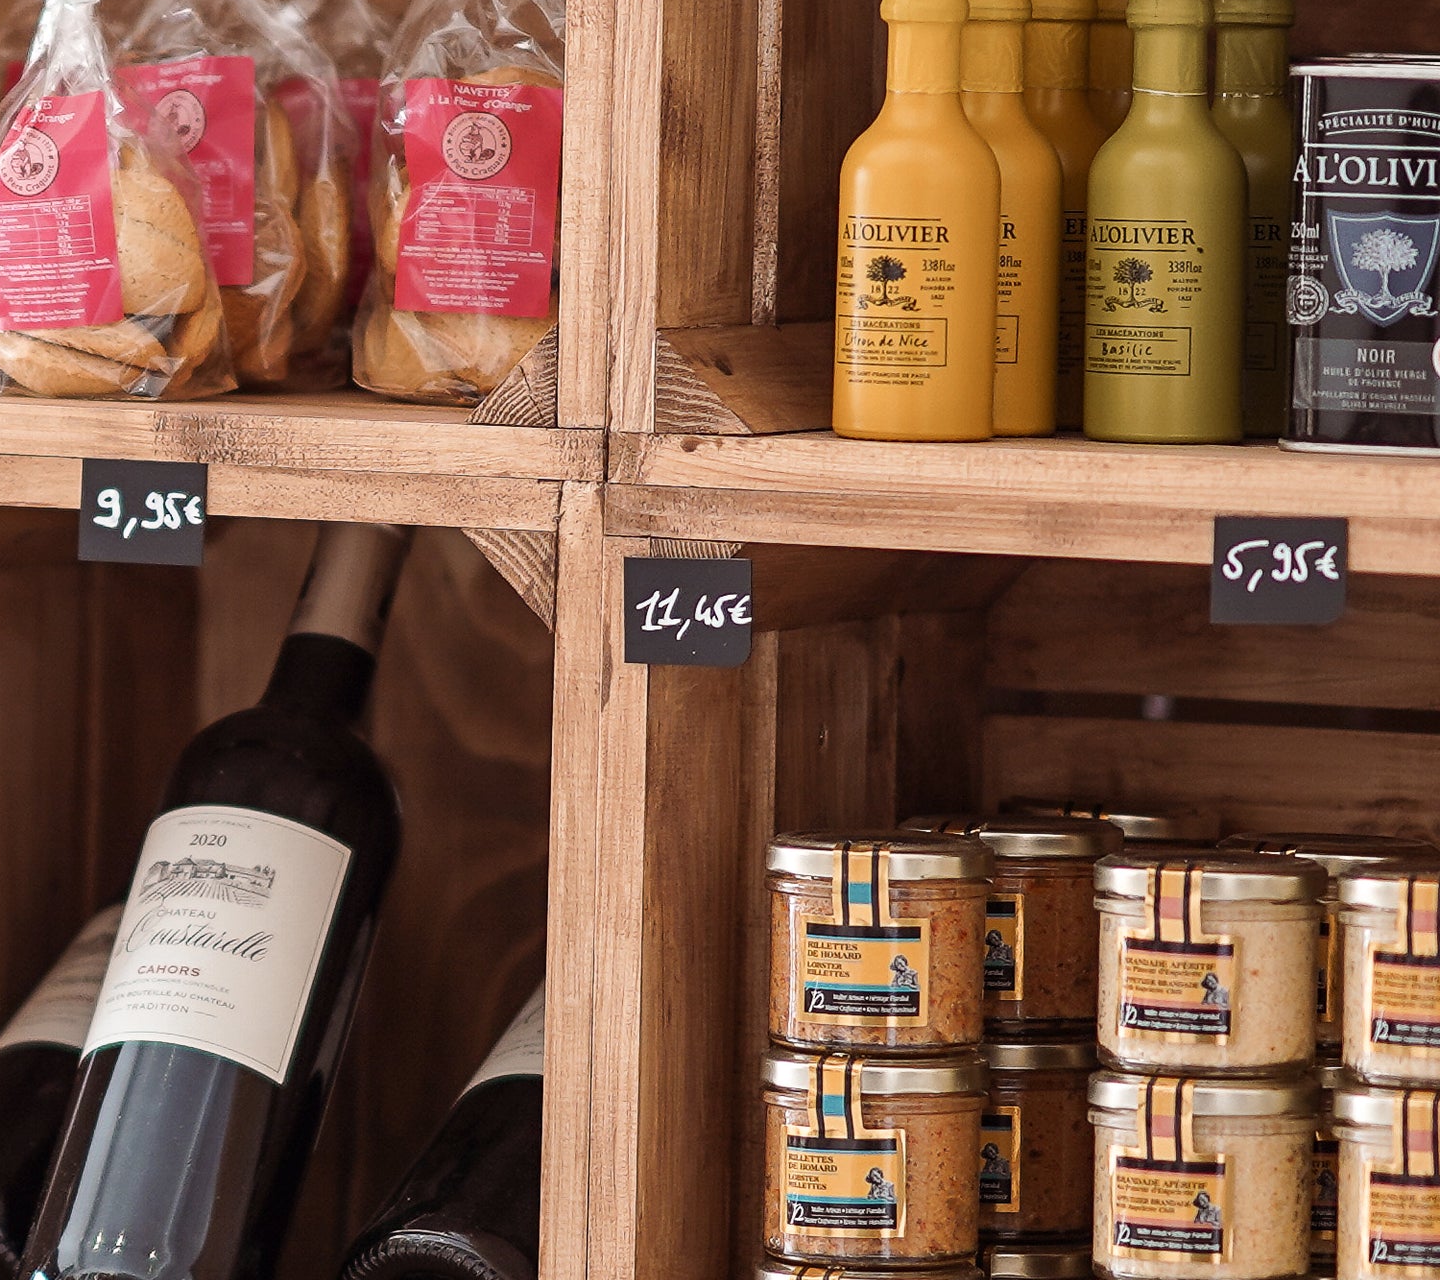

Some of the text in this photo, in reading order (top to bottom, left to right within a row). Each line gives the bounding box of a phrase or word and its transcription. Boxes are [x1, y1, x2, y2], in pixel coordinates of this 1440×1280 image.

[453, 83, 511, 99] NAVETTES
[1317, 113, 1394, 131] SPÉCIALITÉ
[1293, 154, 1312, 183] A
[878, 334, 895, 348] de
[898, 334, 929, 349] Nice
[1101, 342, 1153, 357] Basilic
[1356, 347, 1397, 365] NOIR
[94, 488, 205, 540] 9,95€
[1222, 540, 1340, 593] 5,95€
[635, 589, 751, 640] 11,45€
[189, 833, 228, 848] 2020
[156, 908, 218, 920] CHATEAU
[807, 941, 858, 951] RILLETTES
[137, 964, 201, 977] CAHORS
[126, 1002, 189, 1014] TRADITION
